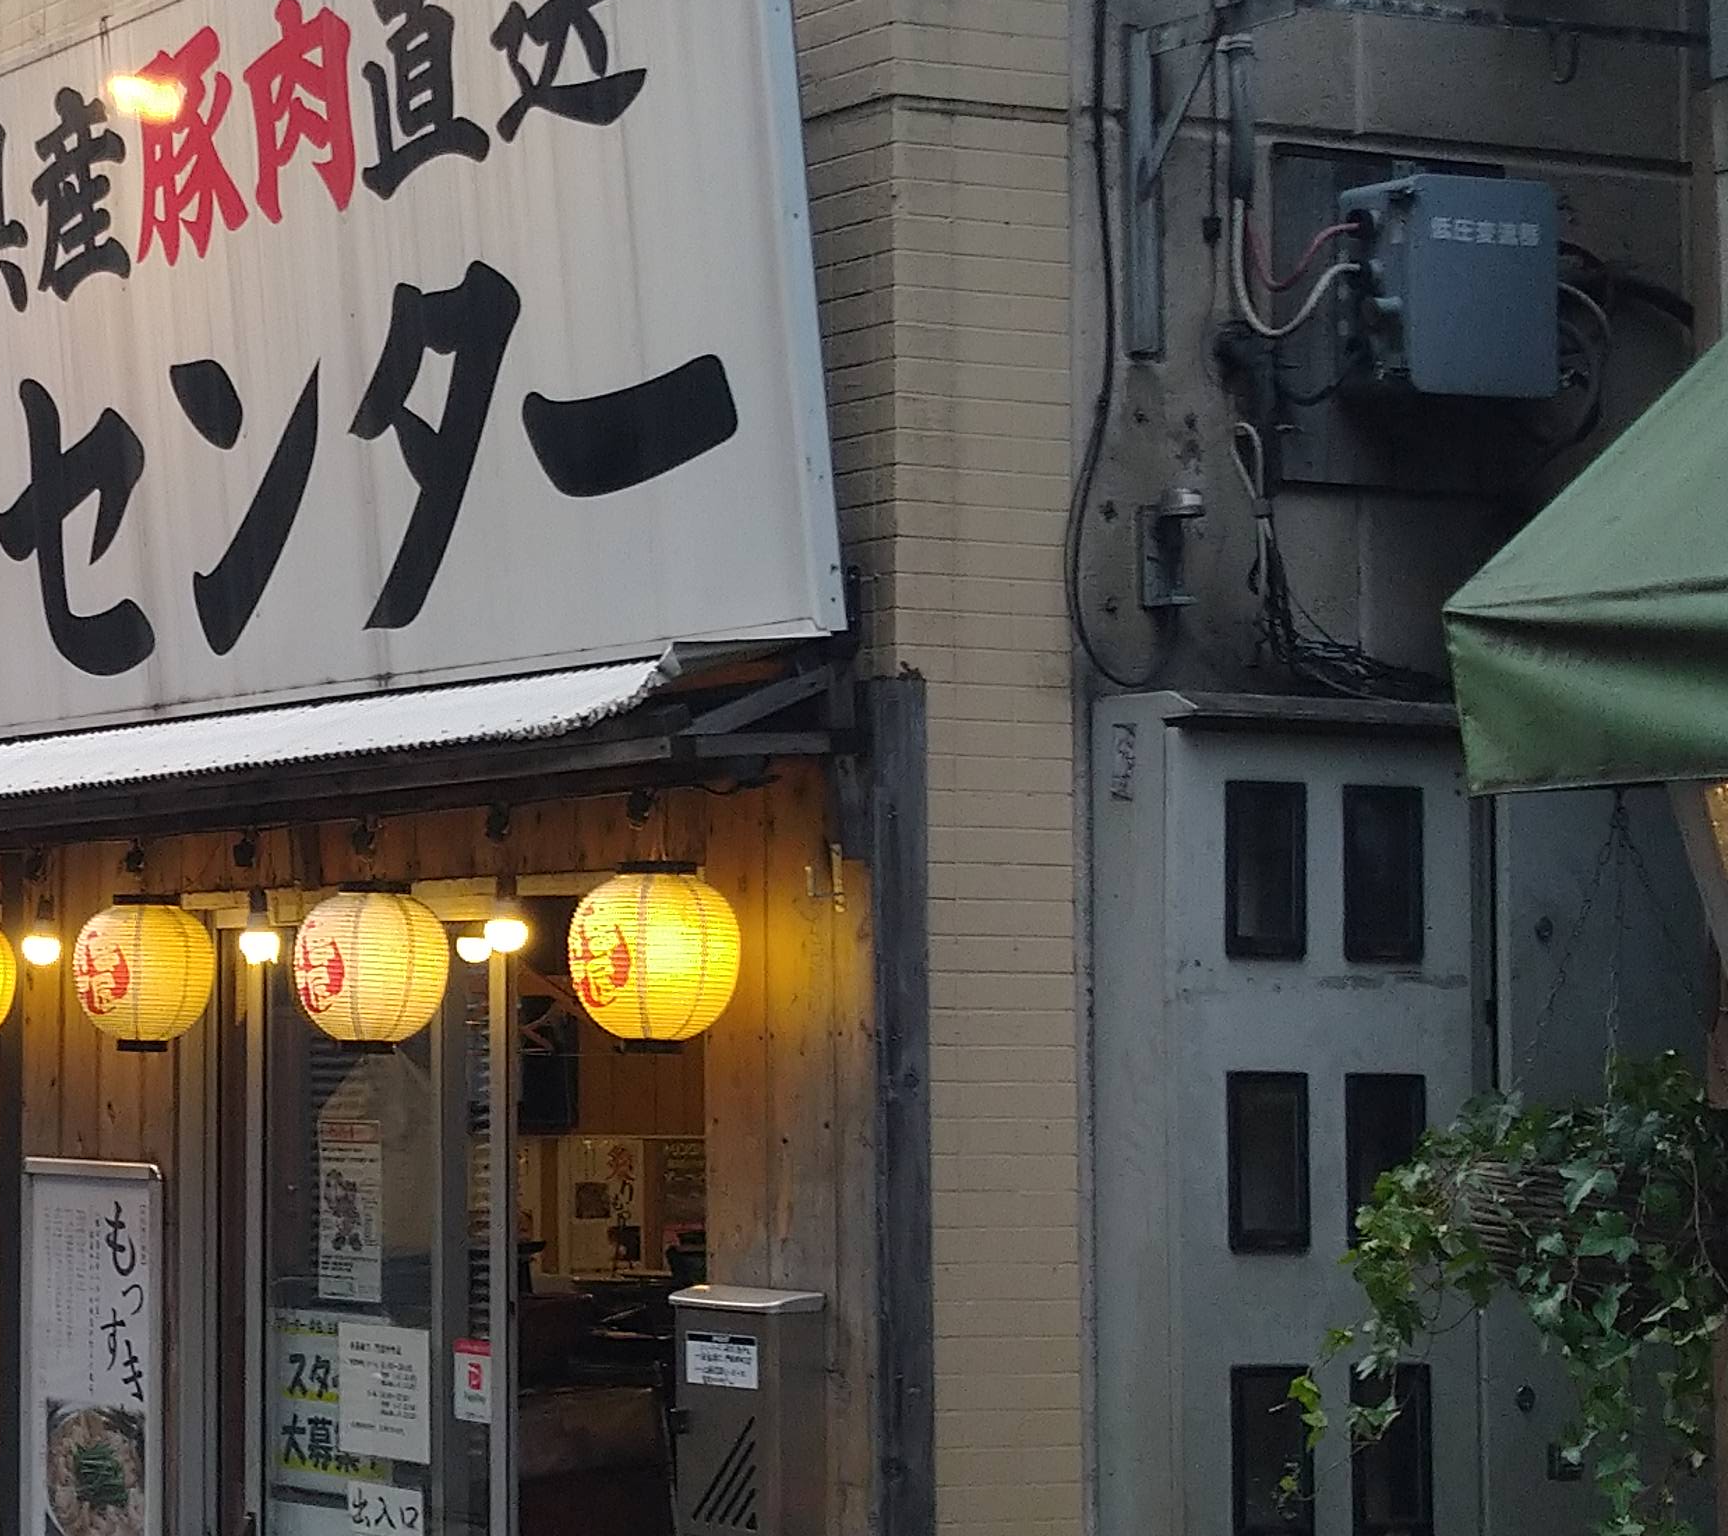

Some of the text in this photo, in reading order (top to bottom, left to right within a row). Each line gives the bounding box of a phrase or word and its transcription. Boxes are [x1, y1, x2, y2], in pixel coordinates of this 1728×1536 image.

[100, 1200, 145, 1403] もつすき
[351, 1487, 420, 1531] 出入口
